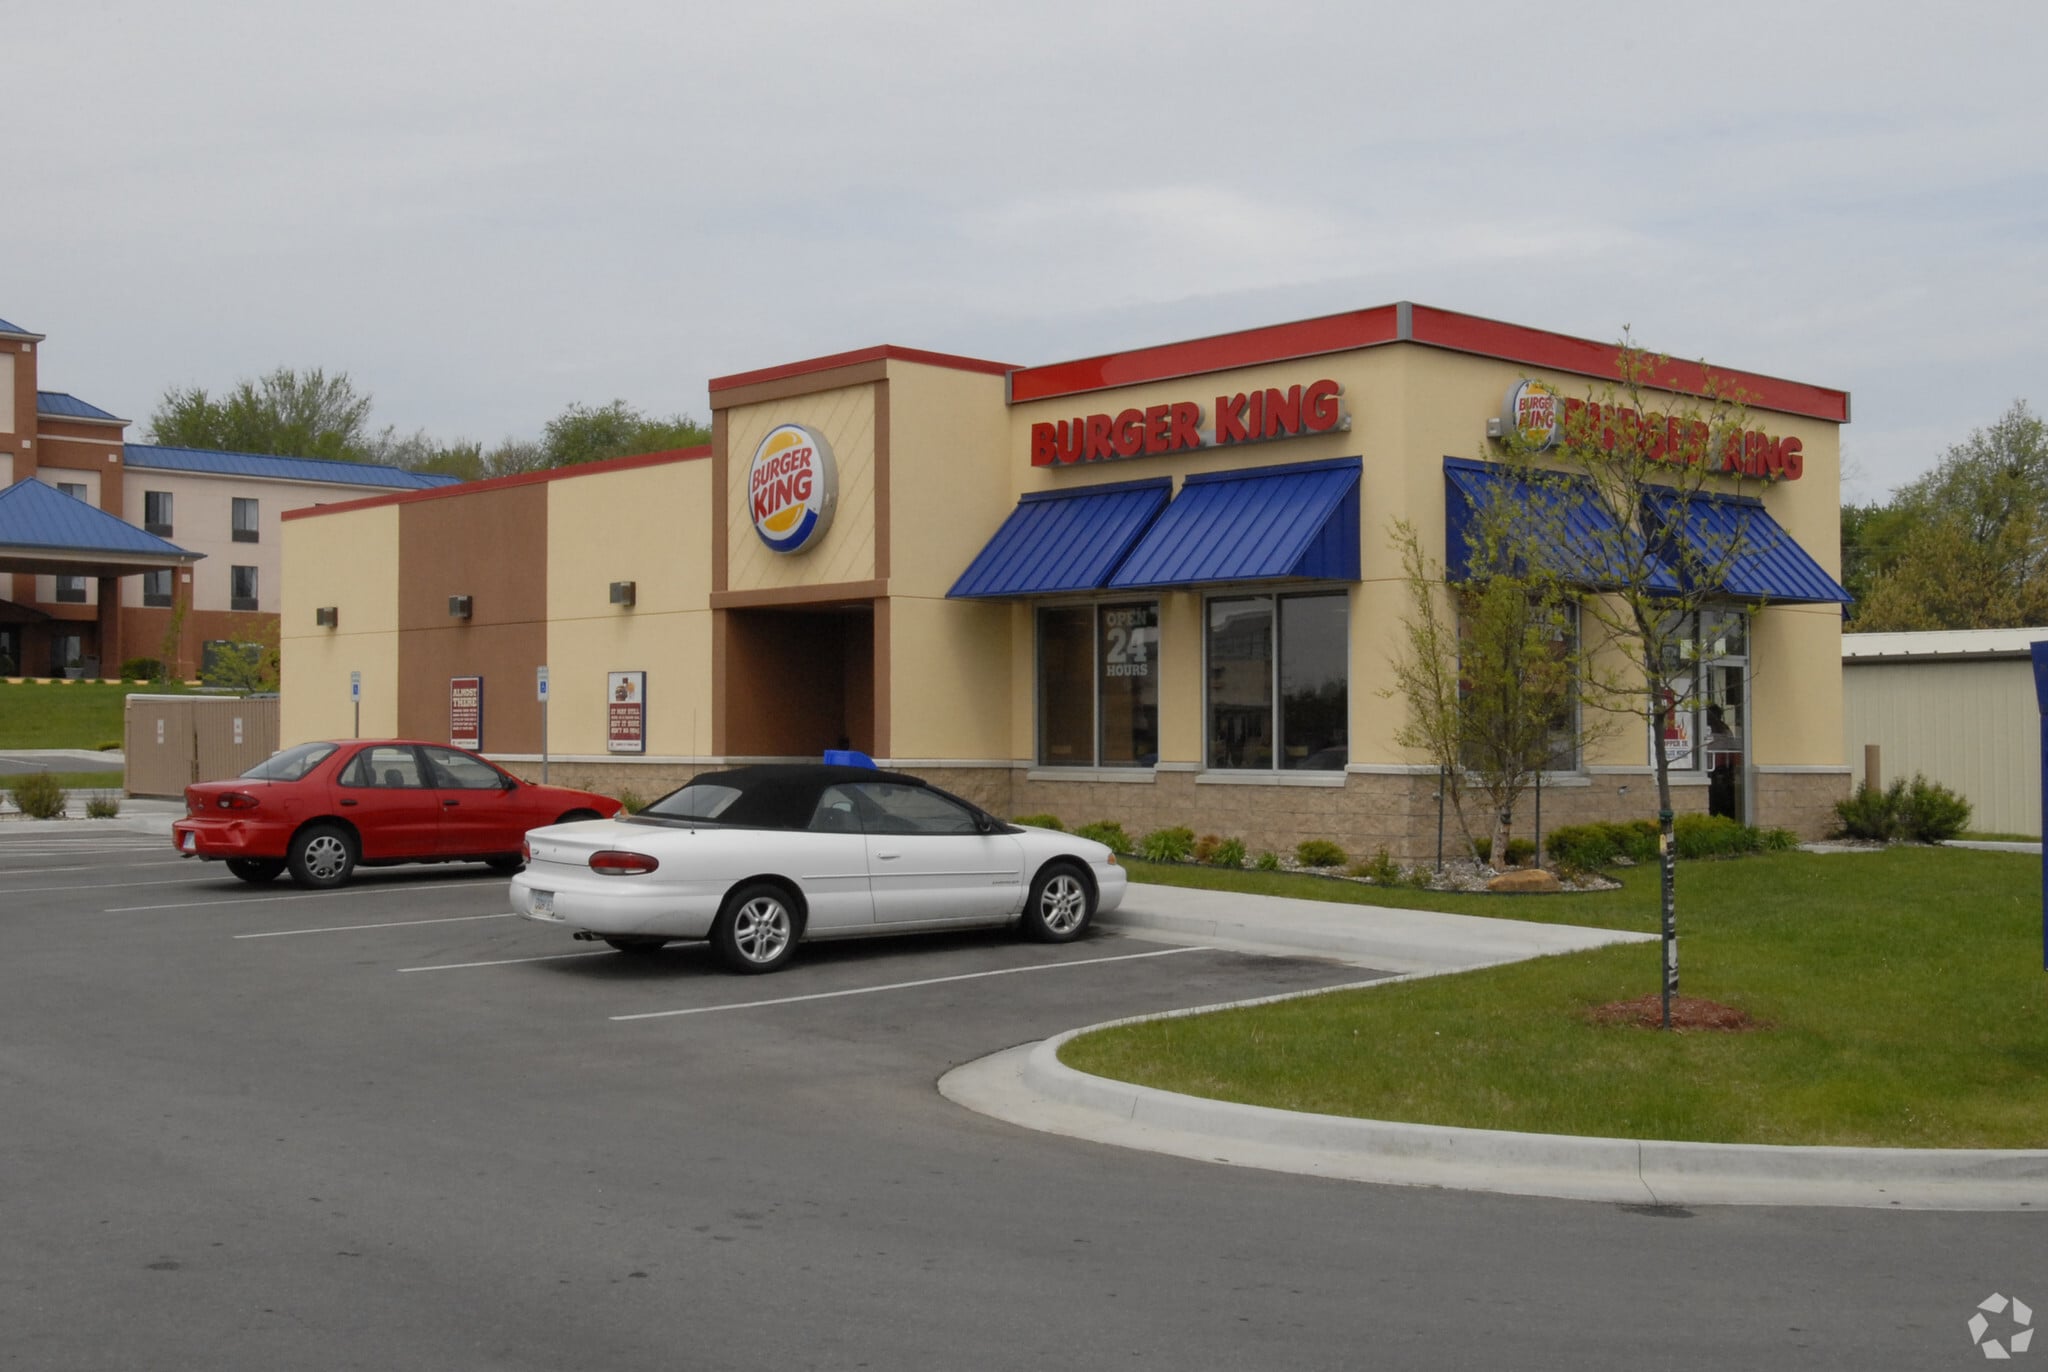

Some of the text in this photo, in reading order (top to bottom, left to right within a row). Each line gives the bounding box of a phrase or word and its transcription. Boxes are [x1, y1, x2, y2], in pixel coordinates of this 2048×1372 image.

[1031, 379, 1340, 467] BURGER KING
[751, 447, 813, 493] BURGER
[753, 468, 813, 524] KING
[1107, 610, 1147, 627] OPEN
[1106, 628, 1147, 663] 24
[1106, 664, 1148, 676] HOURS
